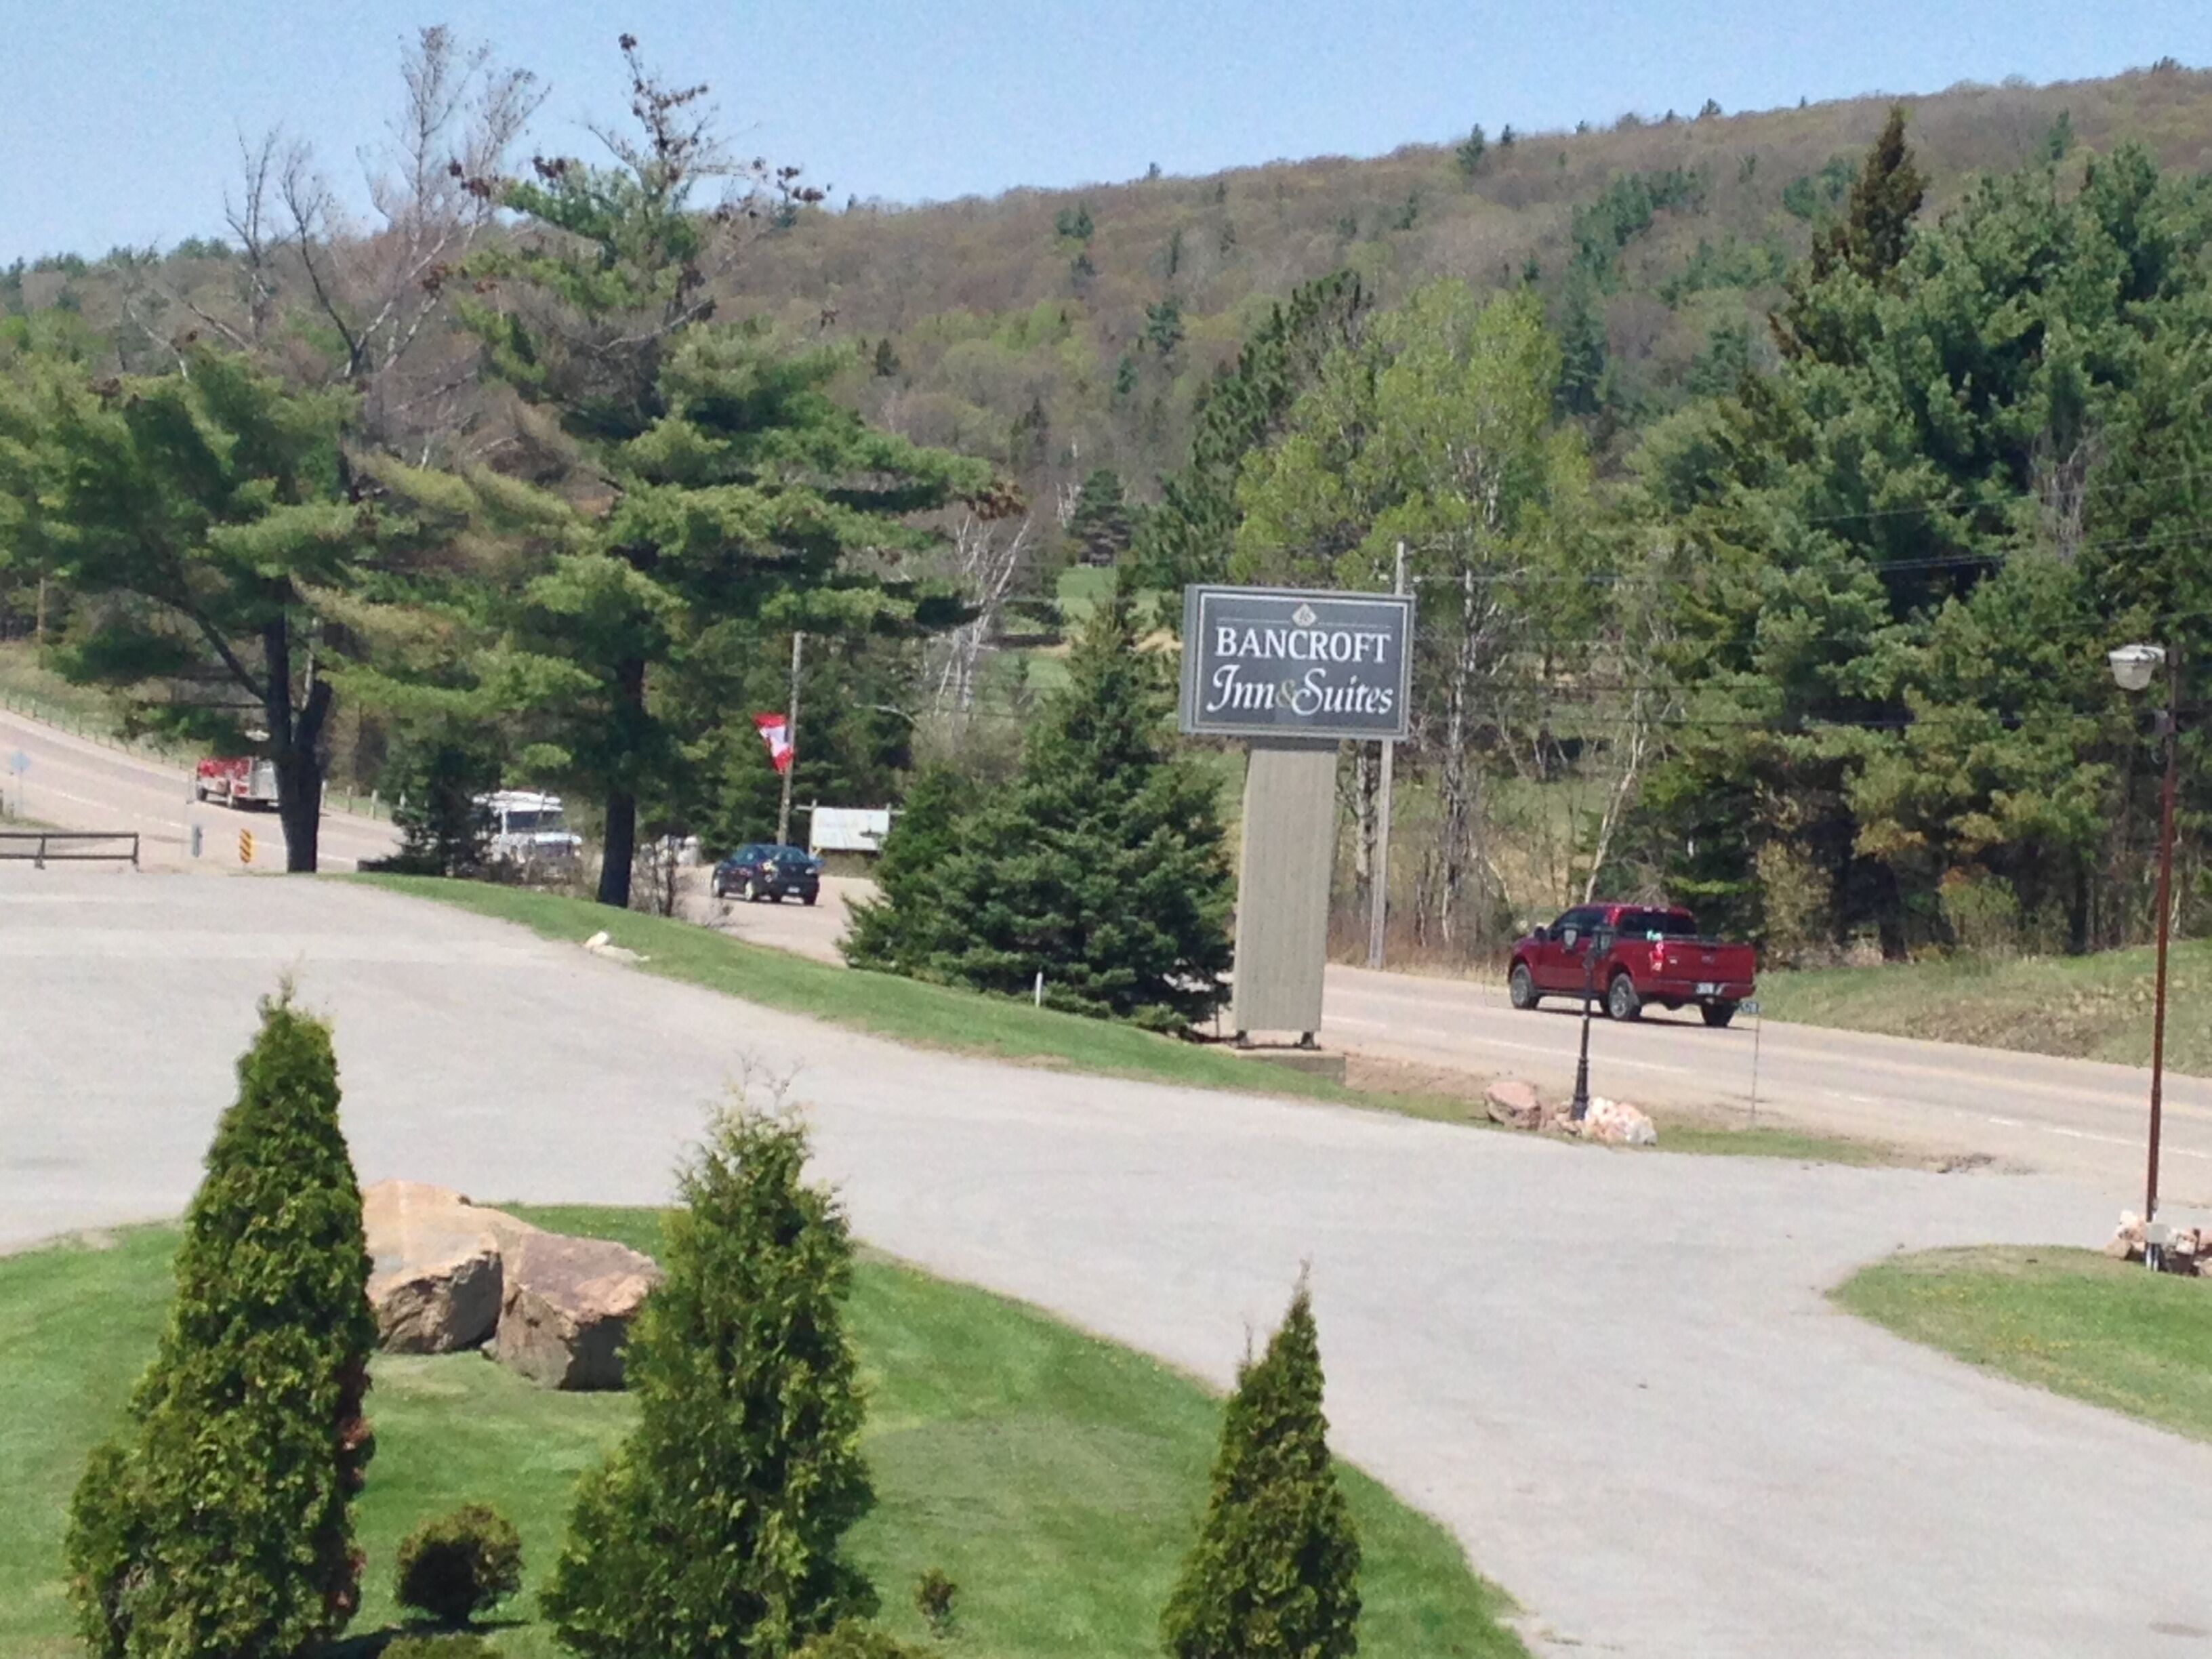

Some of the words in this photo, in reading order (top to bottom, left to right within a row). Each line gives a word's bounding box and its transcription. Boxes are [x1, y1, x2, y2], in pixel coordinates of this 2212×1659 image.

[1215, 627, 1391, 663] BANCROFT
[1206, 664, 1275, 712] Inn
[1276, 678, 1296, 708] &
[1292, 668, 1393, 716] Suites
